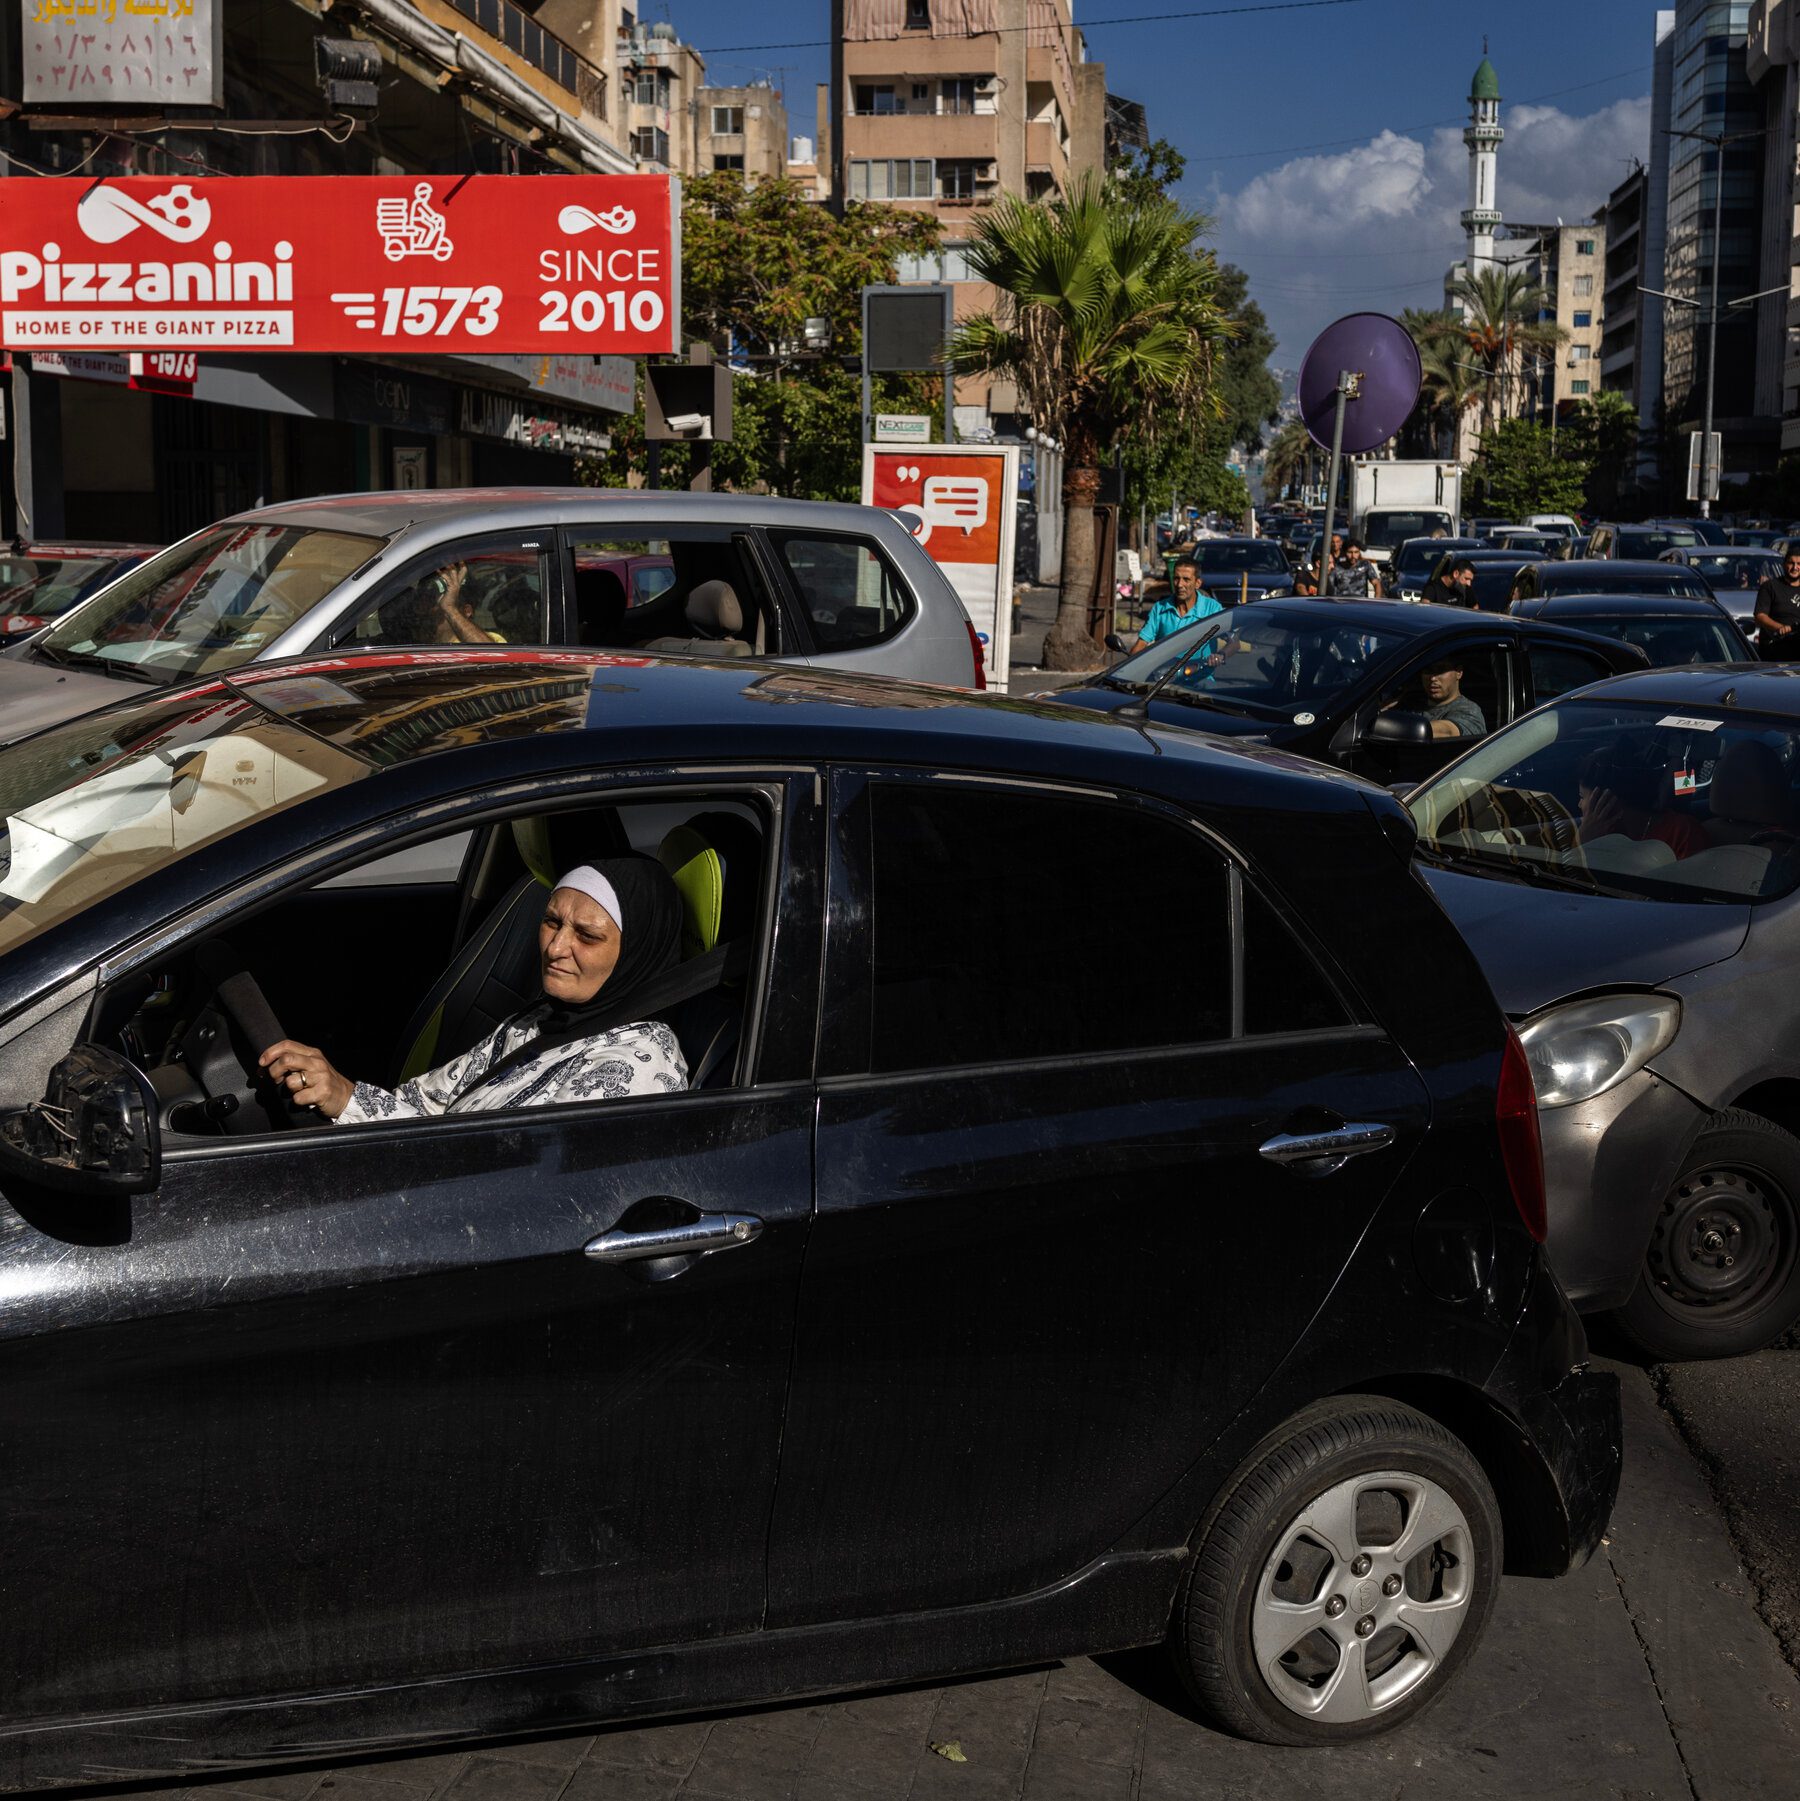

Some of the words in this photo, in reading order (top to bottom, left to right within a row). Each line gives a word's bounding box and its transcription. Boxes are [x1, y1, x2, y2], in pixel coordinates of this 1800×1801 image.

[0, 241, 293, 302] Pizzanini
[539, 249, 660, 282] SINCE
[381, 285, 503, 336] 1573
[539, 290, 664, 332] 2010
[15, 321, 71, 335] HOME
[79, 321, 104, 335] OF
[111, 321, 148, 335] THE
[155, 321, 216, 335] GIANT
[223, 321, 281, 335] PIZZA
[33, 352, 55, 364] HOME
[56, 356, 66, 366] OF
[68, 357, 82, 369] THE
[85, 359, 107, 374] GIANT
[108, 362, 128, 375] PIZZA
[1675, 719, 1706, 727] TAXI
